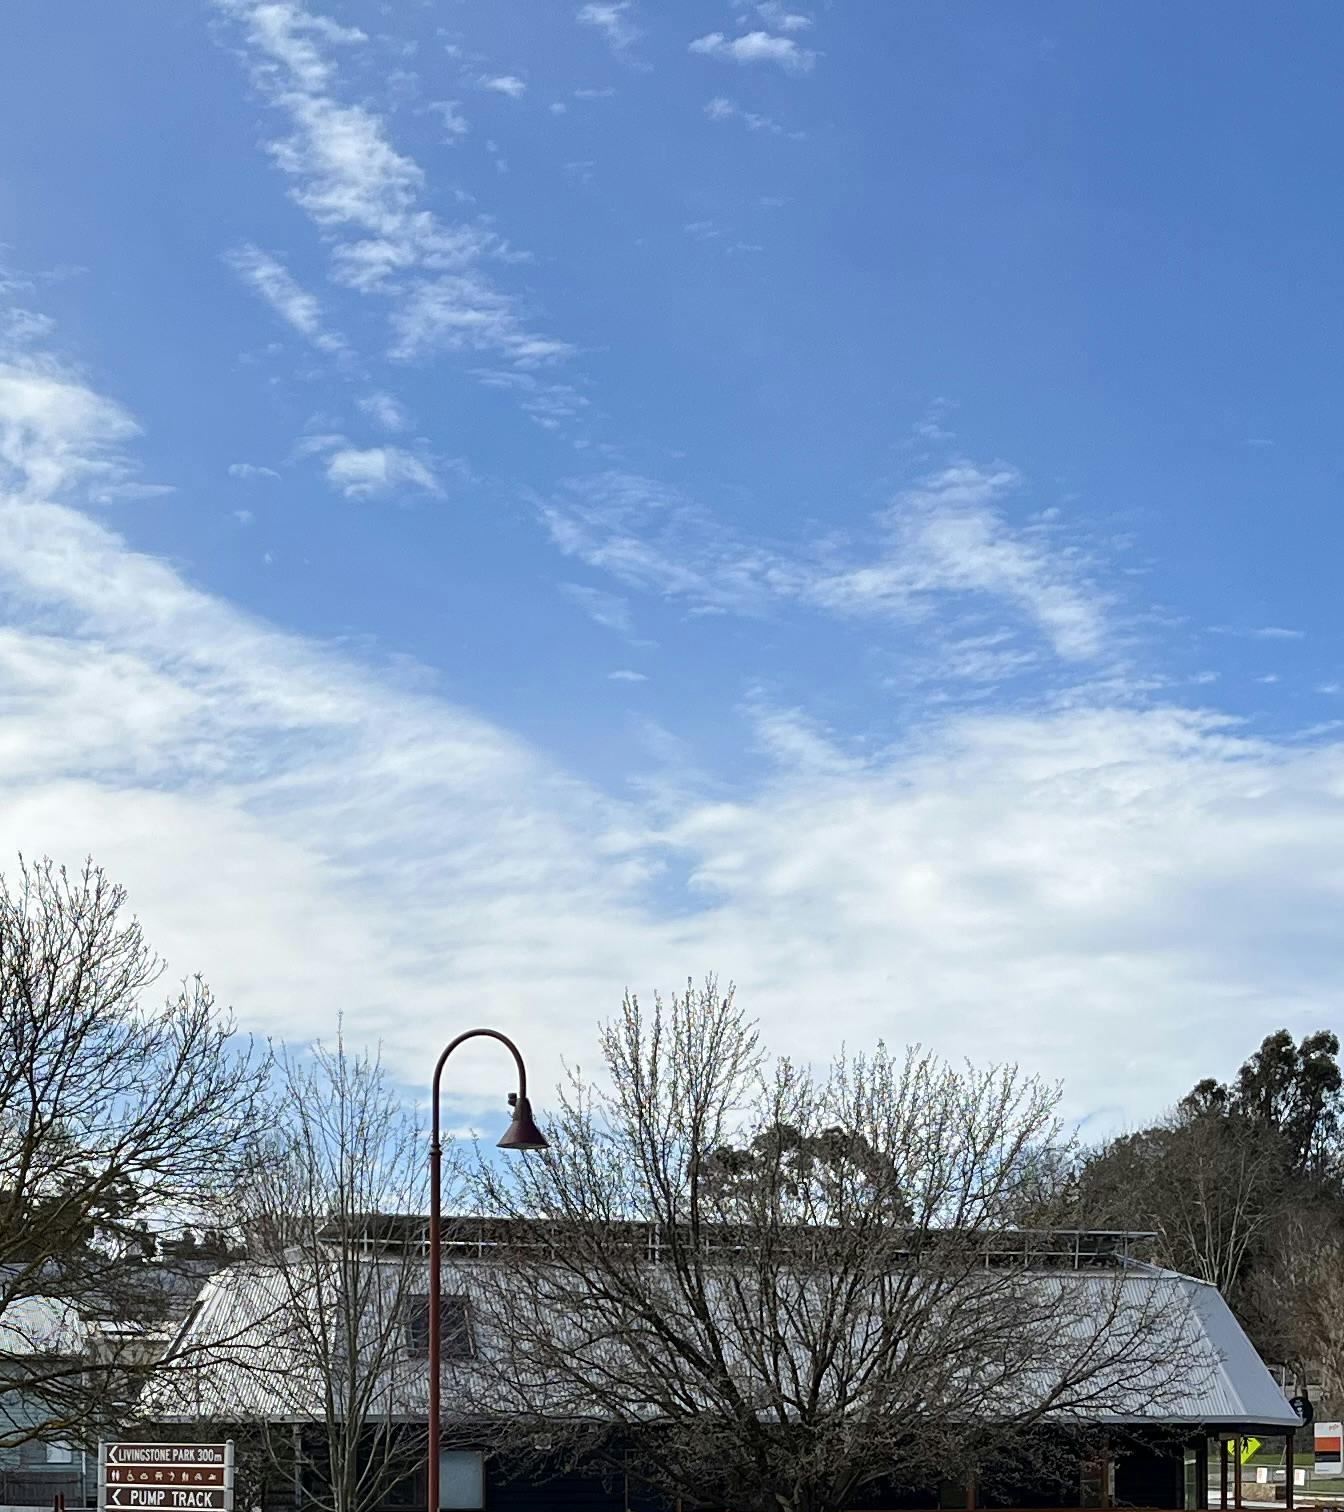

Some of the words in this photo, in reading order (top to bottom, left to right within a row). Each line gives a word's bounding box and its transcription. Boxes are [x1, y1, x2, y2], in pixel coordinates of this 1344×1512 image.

[118, 1449, 170, 1462] LIVINGSTONE
[172, 1448, 195, 1462] PARK
[197, 1448, 222, 1462] 300m
[130, 1490, 165, 1506] PUMP
[172, 1491, 213, 1508] TRACK
